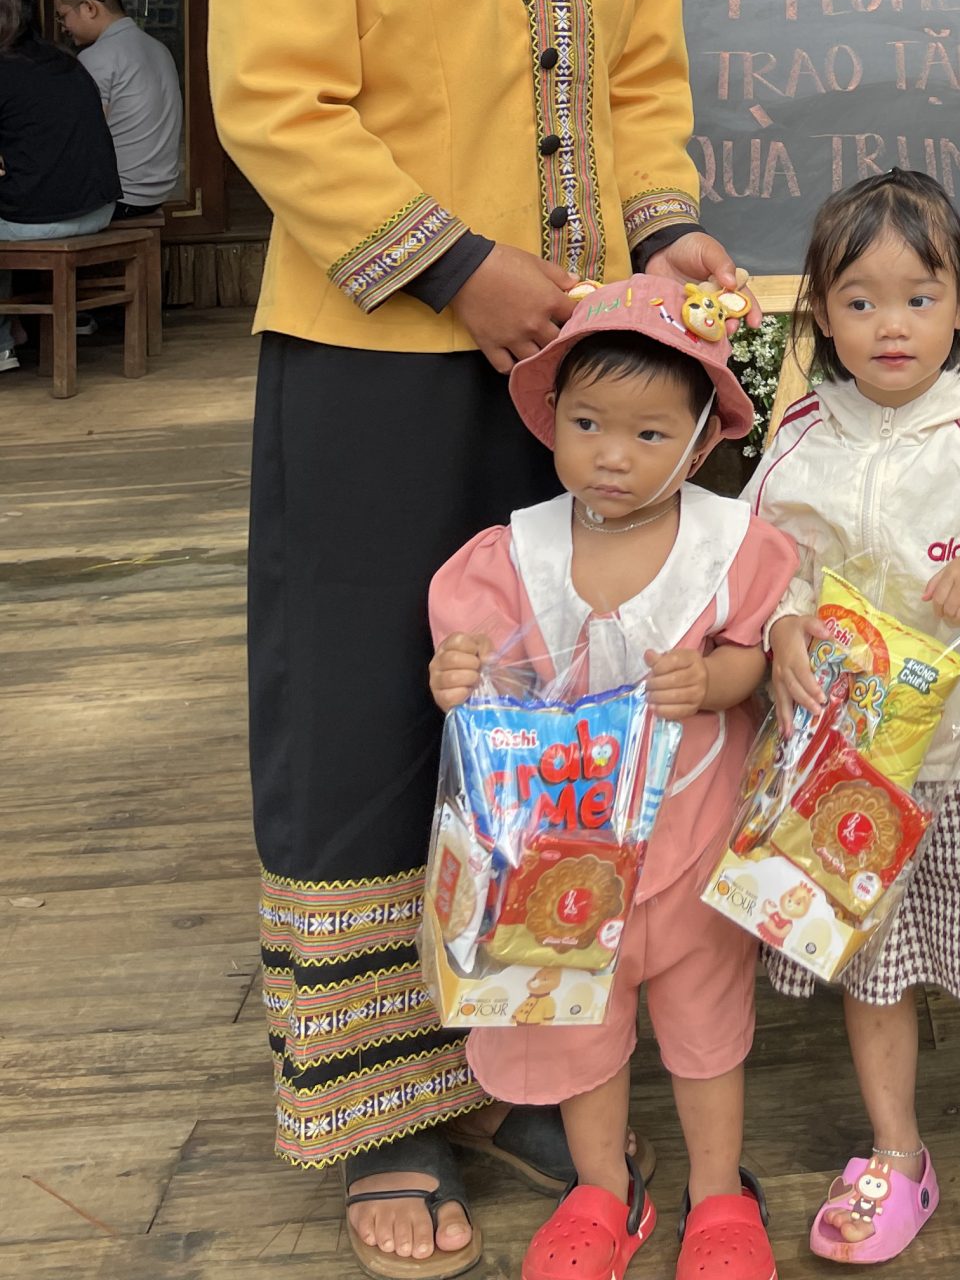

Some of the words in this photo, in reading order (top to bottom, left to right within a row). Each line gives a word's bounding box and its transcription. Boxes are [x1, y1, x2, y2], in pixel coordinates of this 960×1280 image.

[703, 44, 863, 100] TRAO
[485, 719, 621, 812] Crab
[490, 727, 538, 749] Oishi
